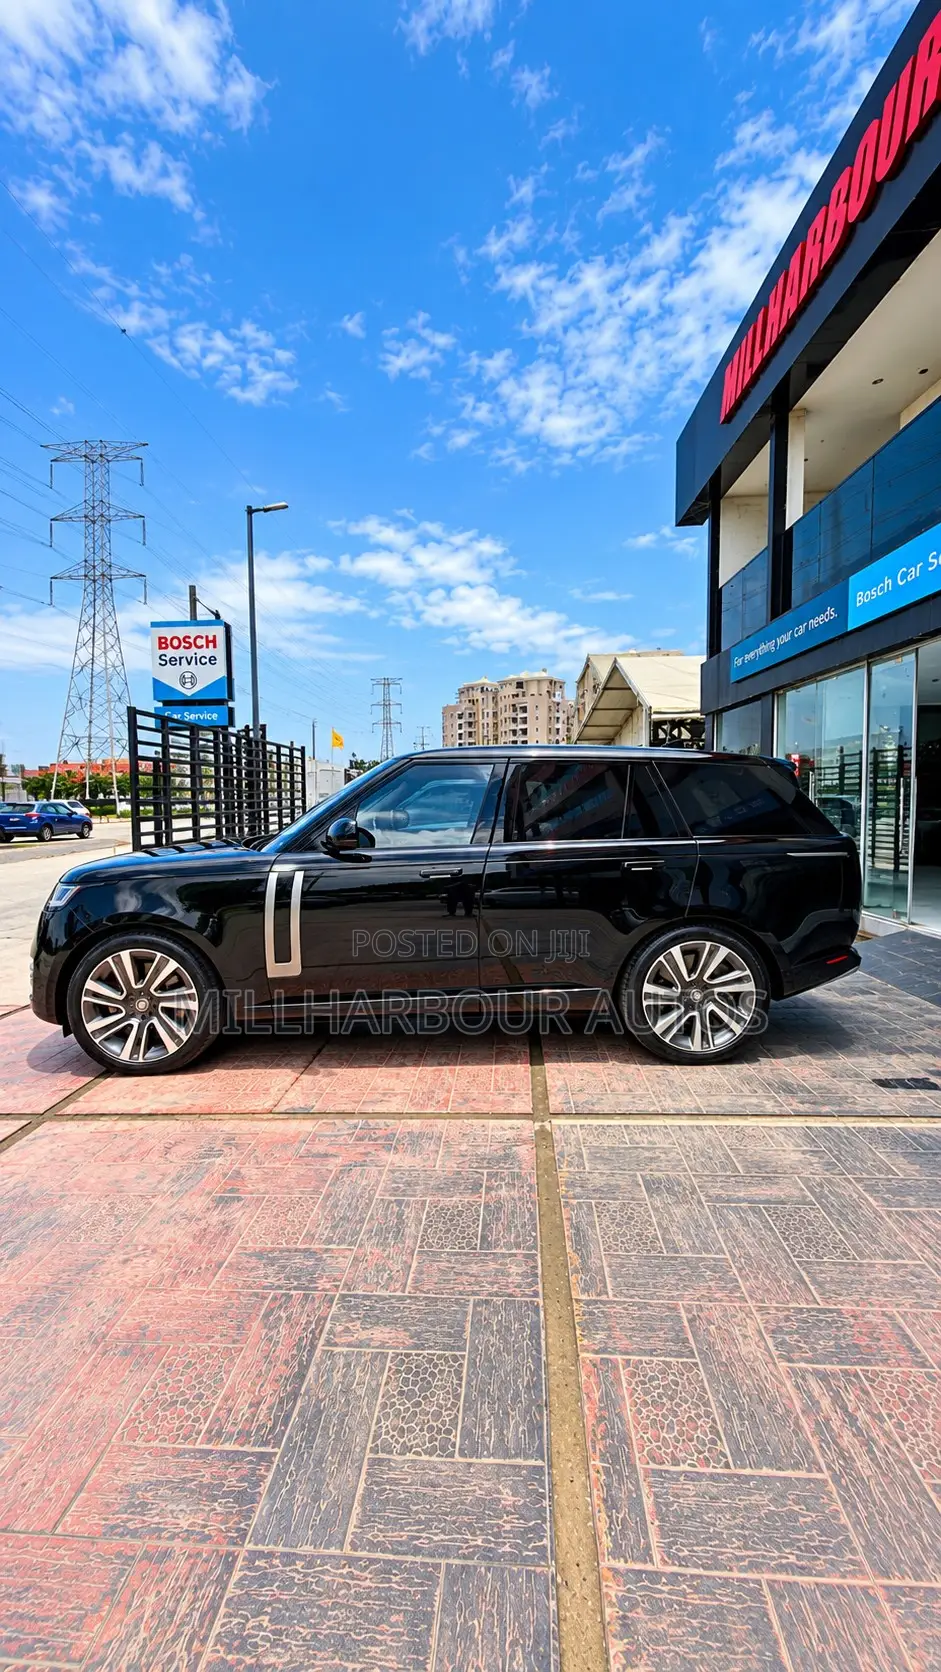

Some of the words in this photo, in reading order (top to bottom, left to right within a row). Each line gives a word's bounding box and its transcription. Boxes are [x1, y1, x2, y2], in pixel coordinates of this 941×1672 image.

[719, 9, 941, 425] MILLHARBOUR
[856, 576, 892, 607] Bosch
[897, 562, 924, 586] Car
[157, 634, 217, 650] BOSCH
[733, 656, 743, 668] For
[744, 639, 776, 661] everything
[776, 630, 793, 650] your
[793, 622, 808, 638] car
[808, 606, 838, 631] needs.
[158, 652, 217, 667] Service
[183, 710, 218, 721] Service
